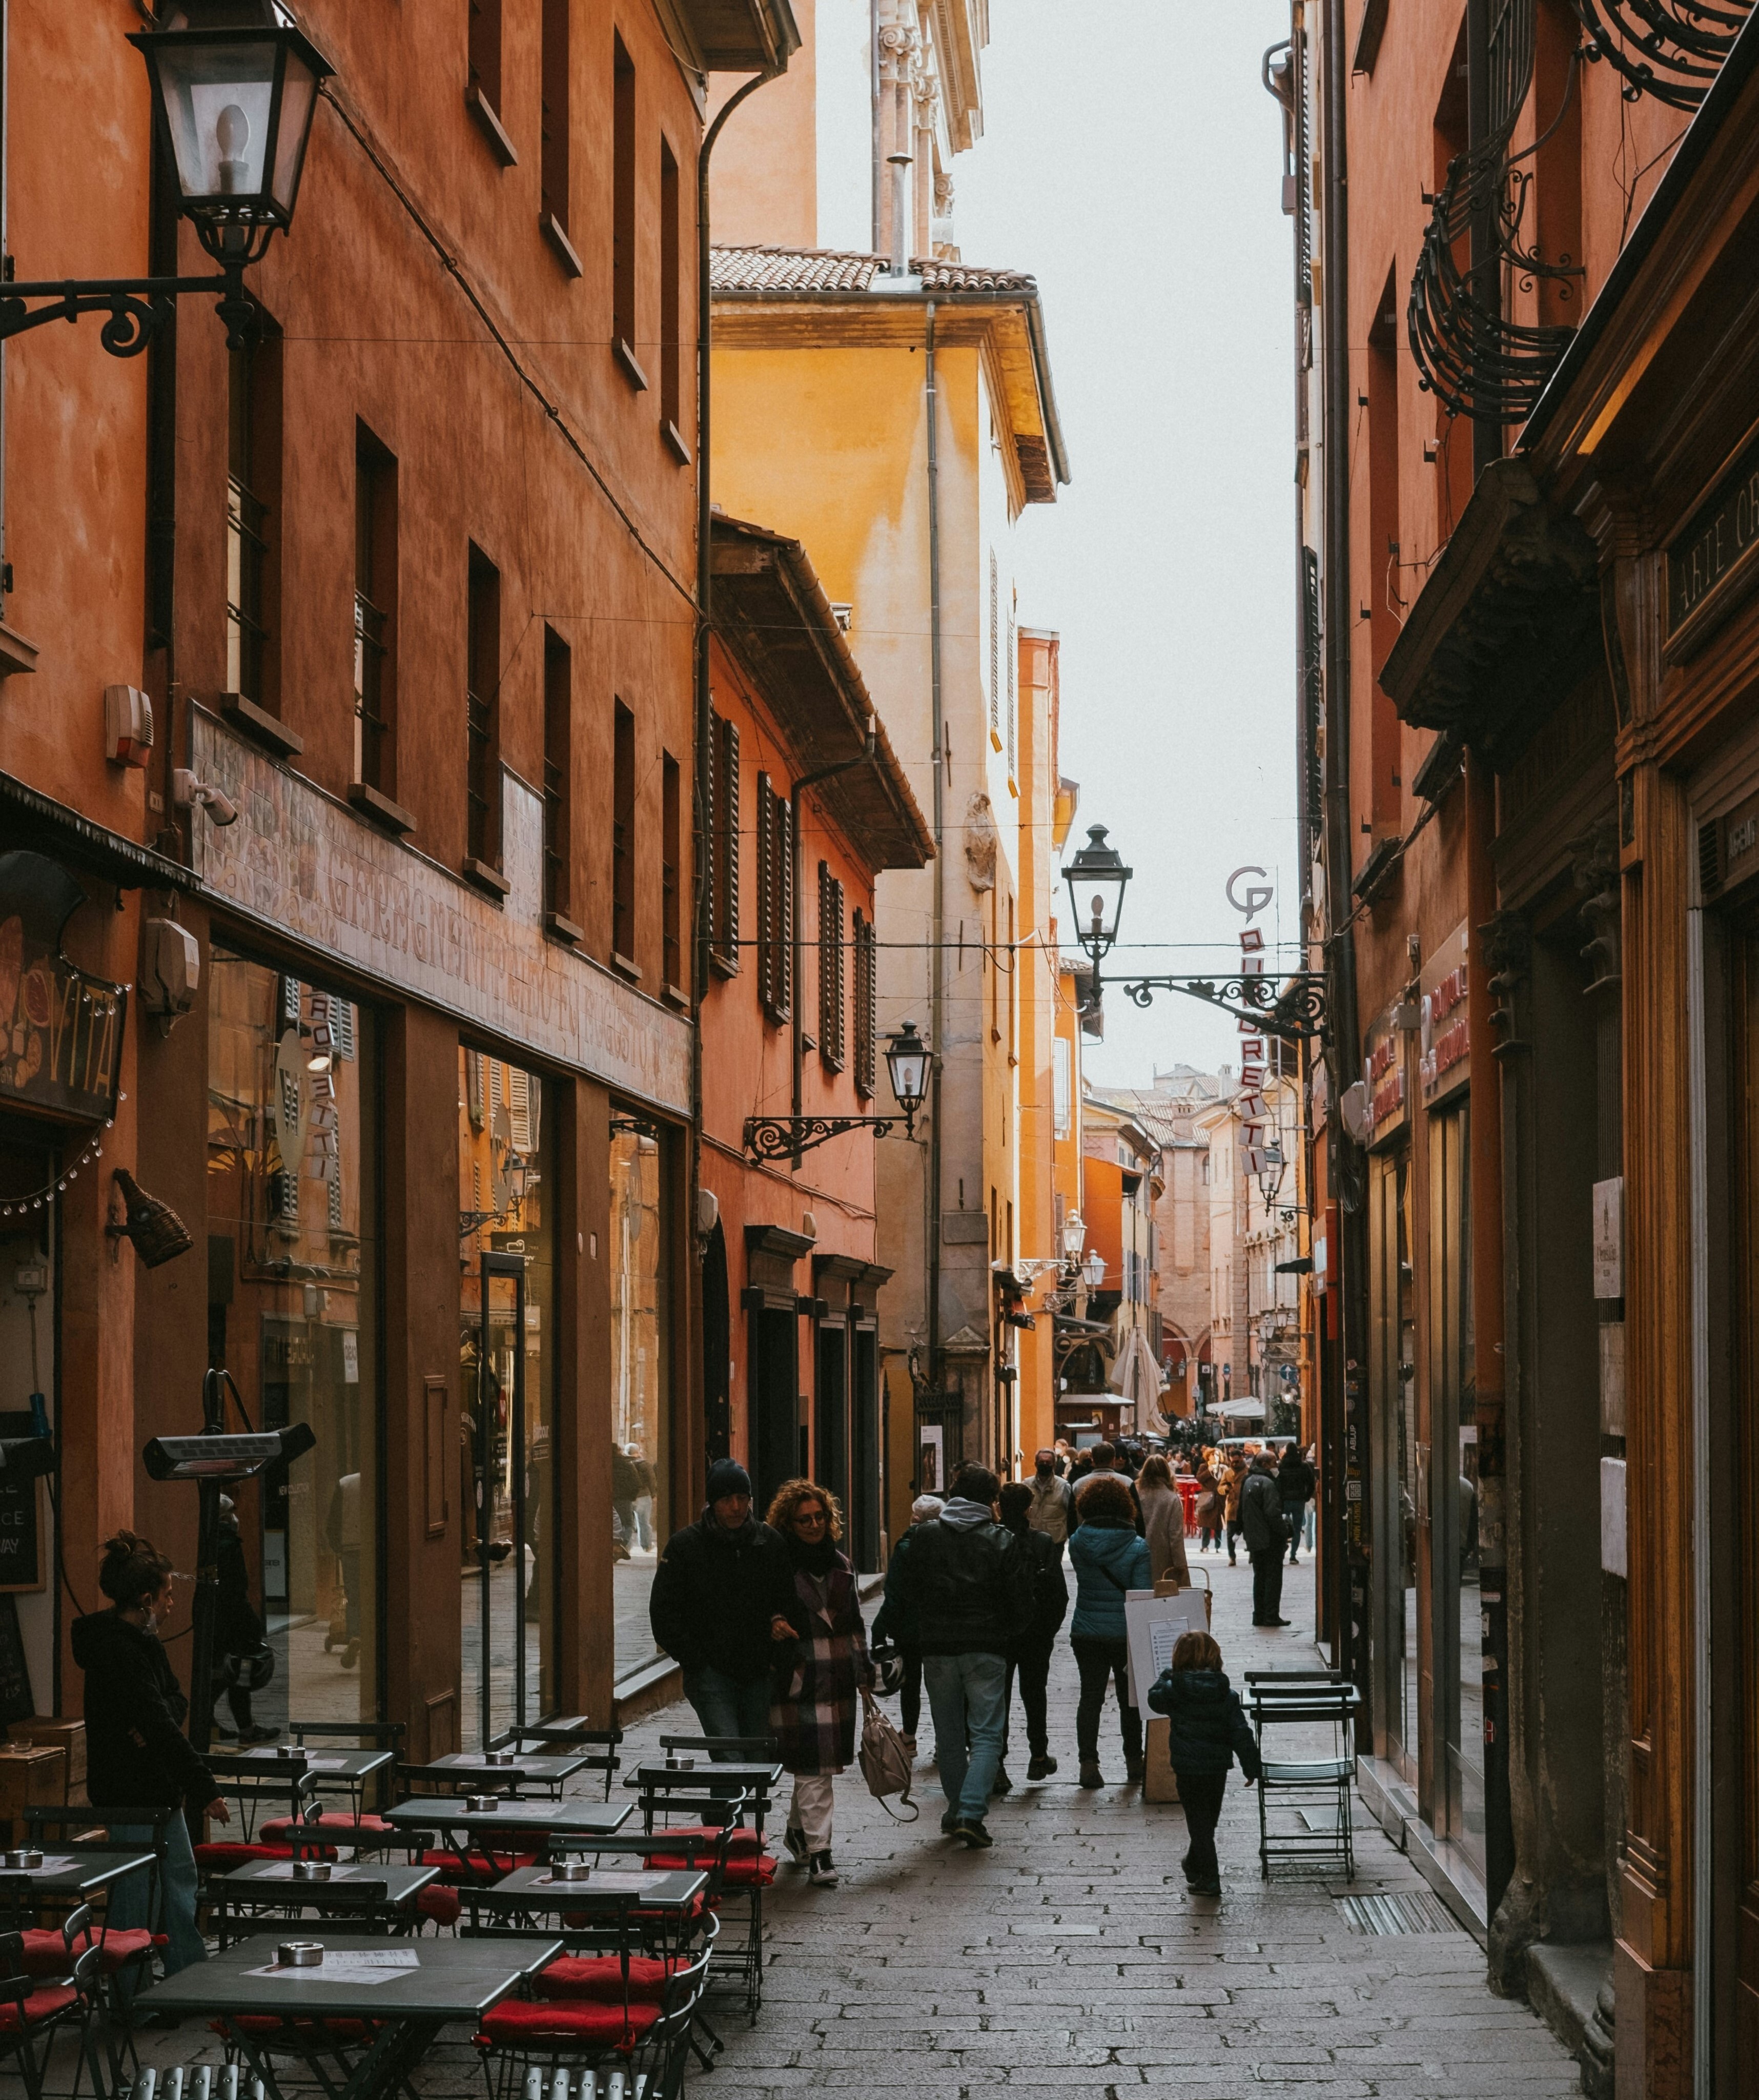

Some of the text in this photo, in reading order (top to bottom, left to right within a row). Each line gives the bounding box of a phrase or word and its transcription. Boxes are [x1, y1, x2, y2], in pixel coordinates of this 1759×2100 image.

[1679, 515, 1726, 618] ARTE
[50, 970, 115, 1099] VITA
[1353, 1502, 1361, 1542] SORRY MOM
